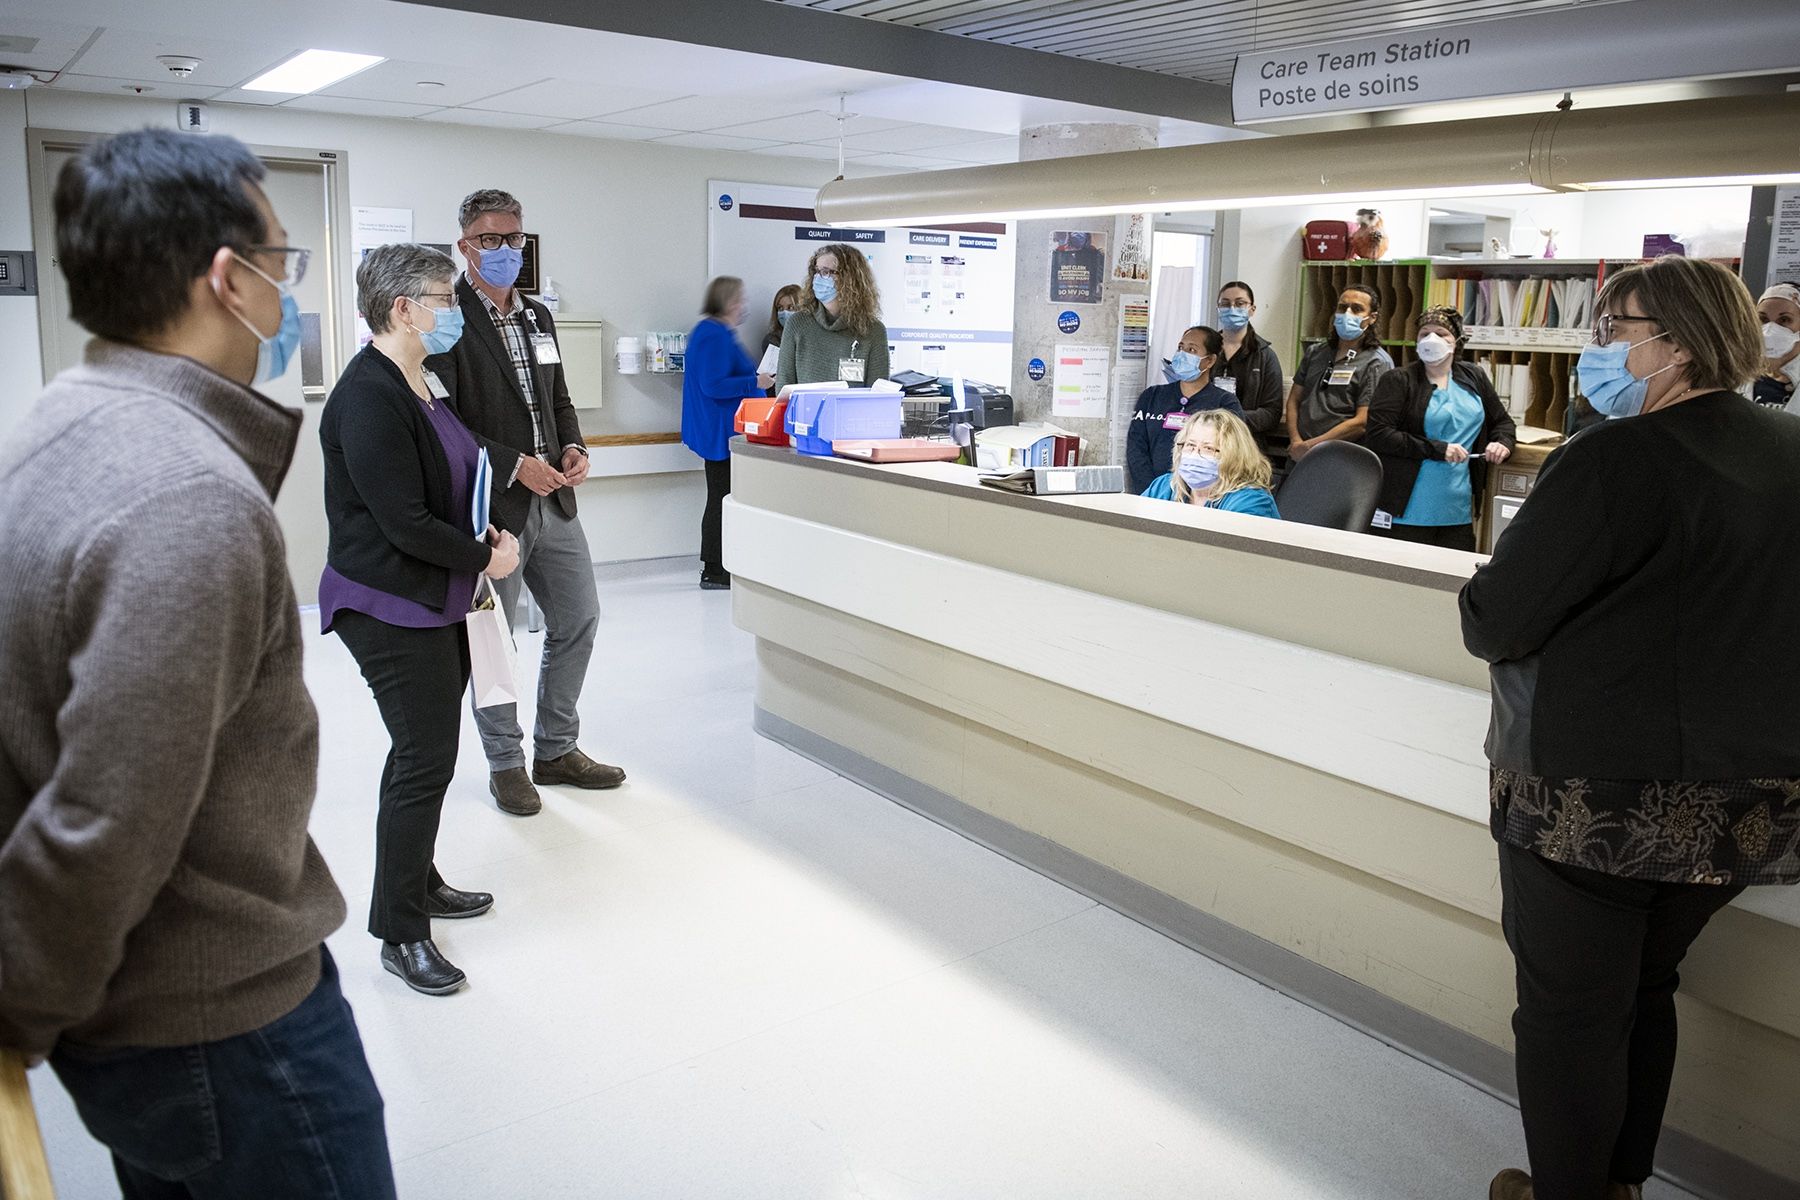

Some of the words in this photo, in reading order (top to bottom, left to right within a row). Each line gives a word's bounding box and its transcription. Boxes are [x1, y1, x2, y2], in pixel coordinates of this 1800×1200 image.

[1260, 60, 1308, 80] Care
[1317, 50, 1376, 73] Team
[1384, 38, 1471, 64] Station
[1259, 86, 1317, 108] Poste
[1324, 80, 1351, 101] de
[1358, 73, 1420, 98] soins
[808, 230, 832, 238] QUALITY
[855, 232, 874, 240] SAFETY
